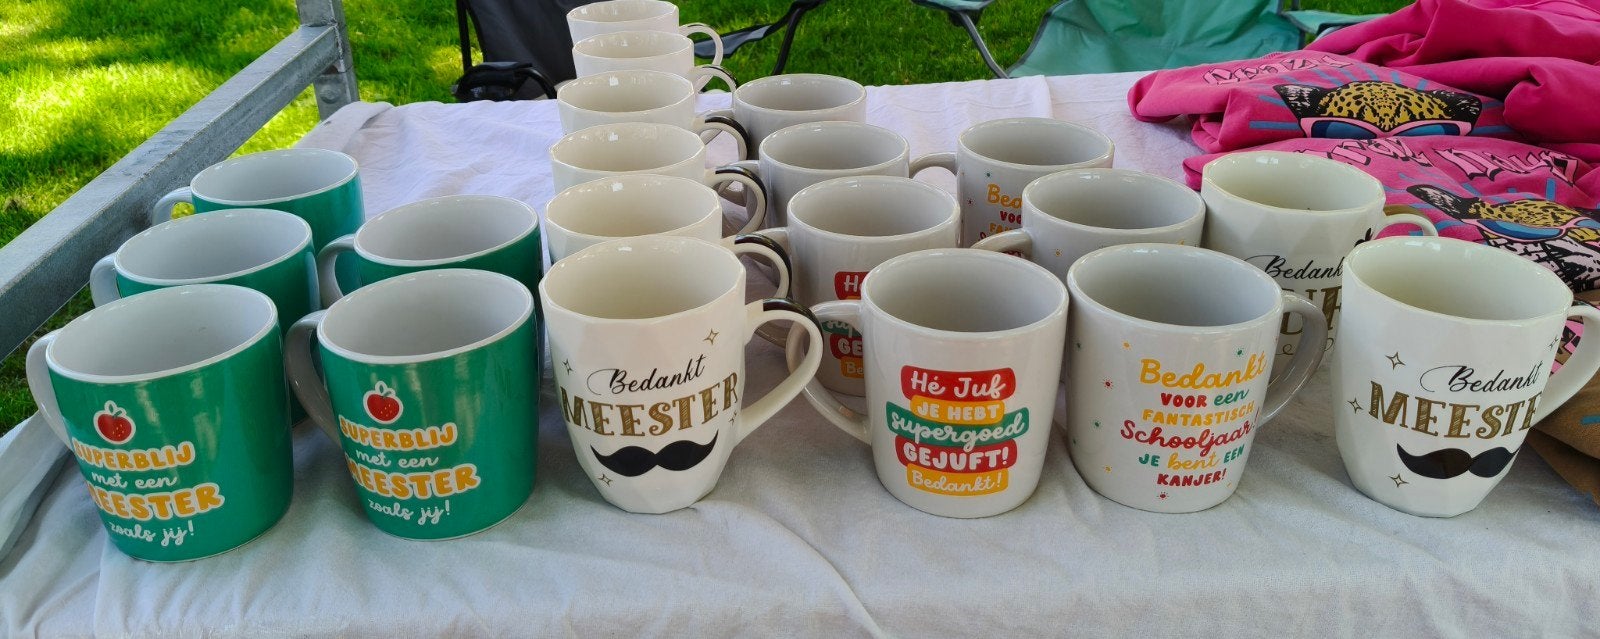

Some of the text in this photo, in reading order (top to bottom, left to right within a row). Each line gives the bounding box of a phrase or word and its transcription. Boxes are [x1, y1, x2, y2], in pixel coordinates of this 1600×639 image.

[587, 353, 706, 396] Bedankt
[1139, 350, 1268, 390] Bedankt
[1419, 360, 1543, 393] Bedankt
[910, 370, 1007, 399] Hé Juf
[1160, 388, 1250, 408] VOOR een
[560, 372, 738, 437] MEESTER
[916, 403, 1000, 421] JE HEBT
[1142, 400, 1256, 427] FANTASTISCH
[339, 416, 458, 450] SUPERBLIJ
[73, 438, 195, 471] SUPERBLIJ
[355, 450, 440, 469] met een
[902, 442, 1010, 470] GEJUFT!
[1138, 444, 1245, 471] JE bent EEN
[91, 471, 178, 489] met een
[911, 470, 1003, 493] Bedankt!
[1156, 467, 1227, 487] KANJER!
[368, 498, 414, 521] zoals
[109, 521, 156, 542] zoals
